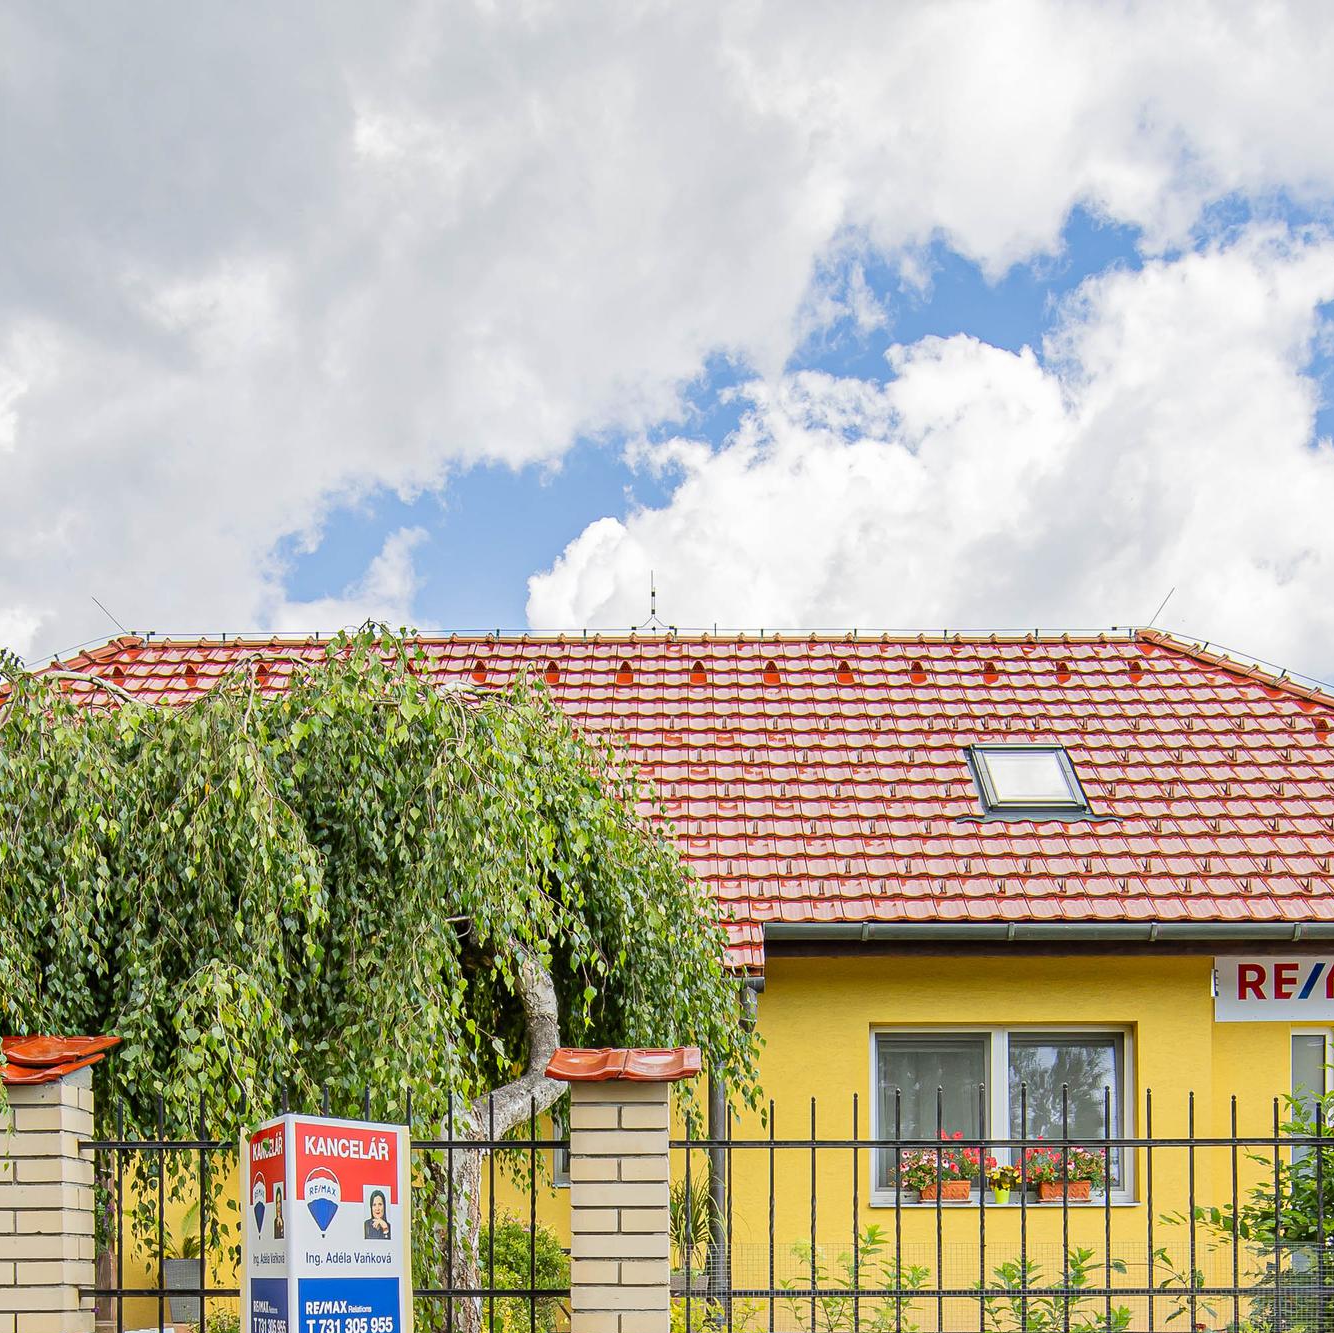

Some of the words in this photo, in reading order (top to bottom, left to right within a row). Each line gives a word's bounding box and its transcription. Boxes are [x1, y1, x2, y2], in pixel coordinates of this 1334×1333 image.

[304, 1135, 389, 1161] KANCELÁŘ
[309, 1184, 336, 1197] RE/MAX
[305, 1252, 323, 1266] Ing.
[326, 1252, 352, 1264] Adéla
[354, 1252, 392, 1264] Vaňková
[305, 1300, 348, 1315] RE/MAX
[348, 1306, 372, 1314] Relations
[253, 1317, 258, 1333] T
[370, 1316, 394, 1333] 955
